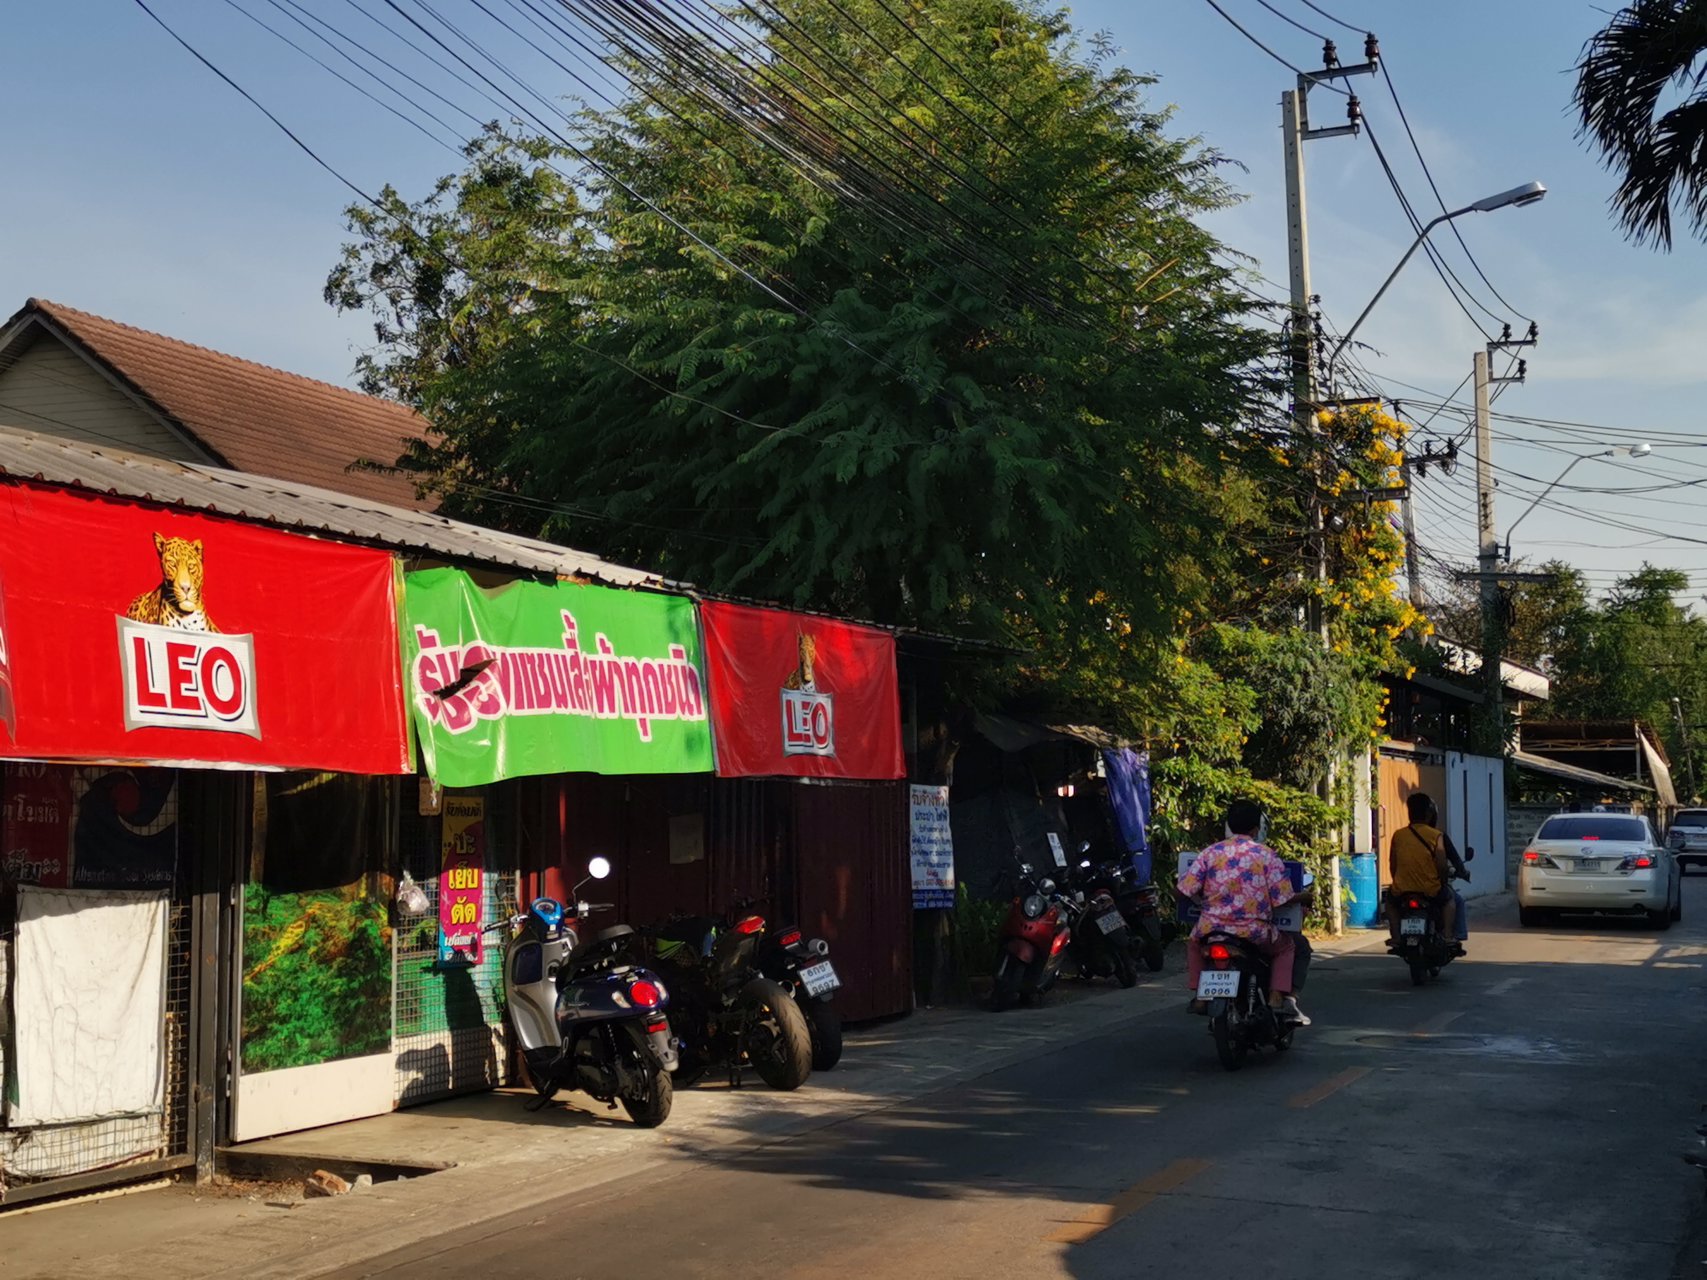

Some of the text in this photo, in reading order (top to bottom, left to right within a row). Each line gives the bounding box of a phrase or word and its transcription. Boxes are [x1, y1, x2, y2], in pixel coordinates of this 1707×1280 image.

[132, 636, 246, 721] LEO
[784, 698, 831, 749] LEO
[448, 862, 478, 890] เย็บ
[451, 896, 477, 925] ตัด
